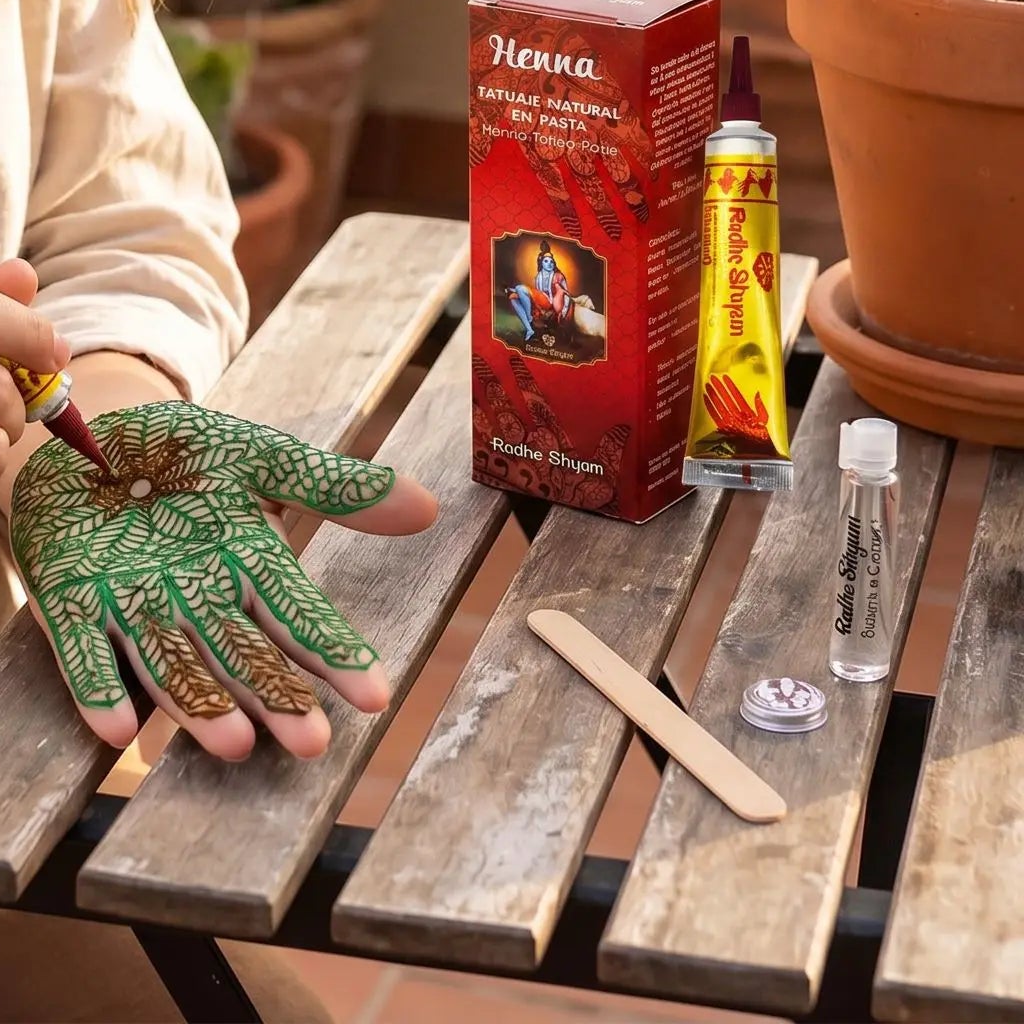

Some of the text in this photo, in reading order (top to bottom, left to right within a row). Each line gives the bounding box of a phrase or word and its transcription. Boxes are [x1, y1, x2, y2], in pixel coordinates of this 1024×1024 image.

[488, 34, 603, 81] Henna
[511, 109, 587, 132] EN PASTA
[547, 98, 622, 120] NATURAL
[489, 437, 604, 475] Radhe Shyam
